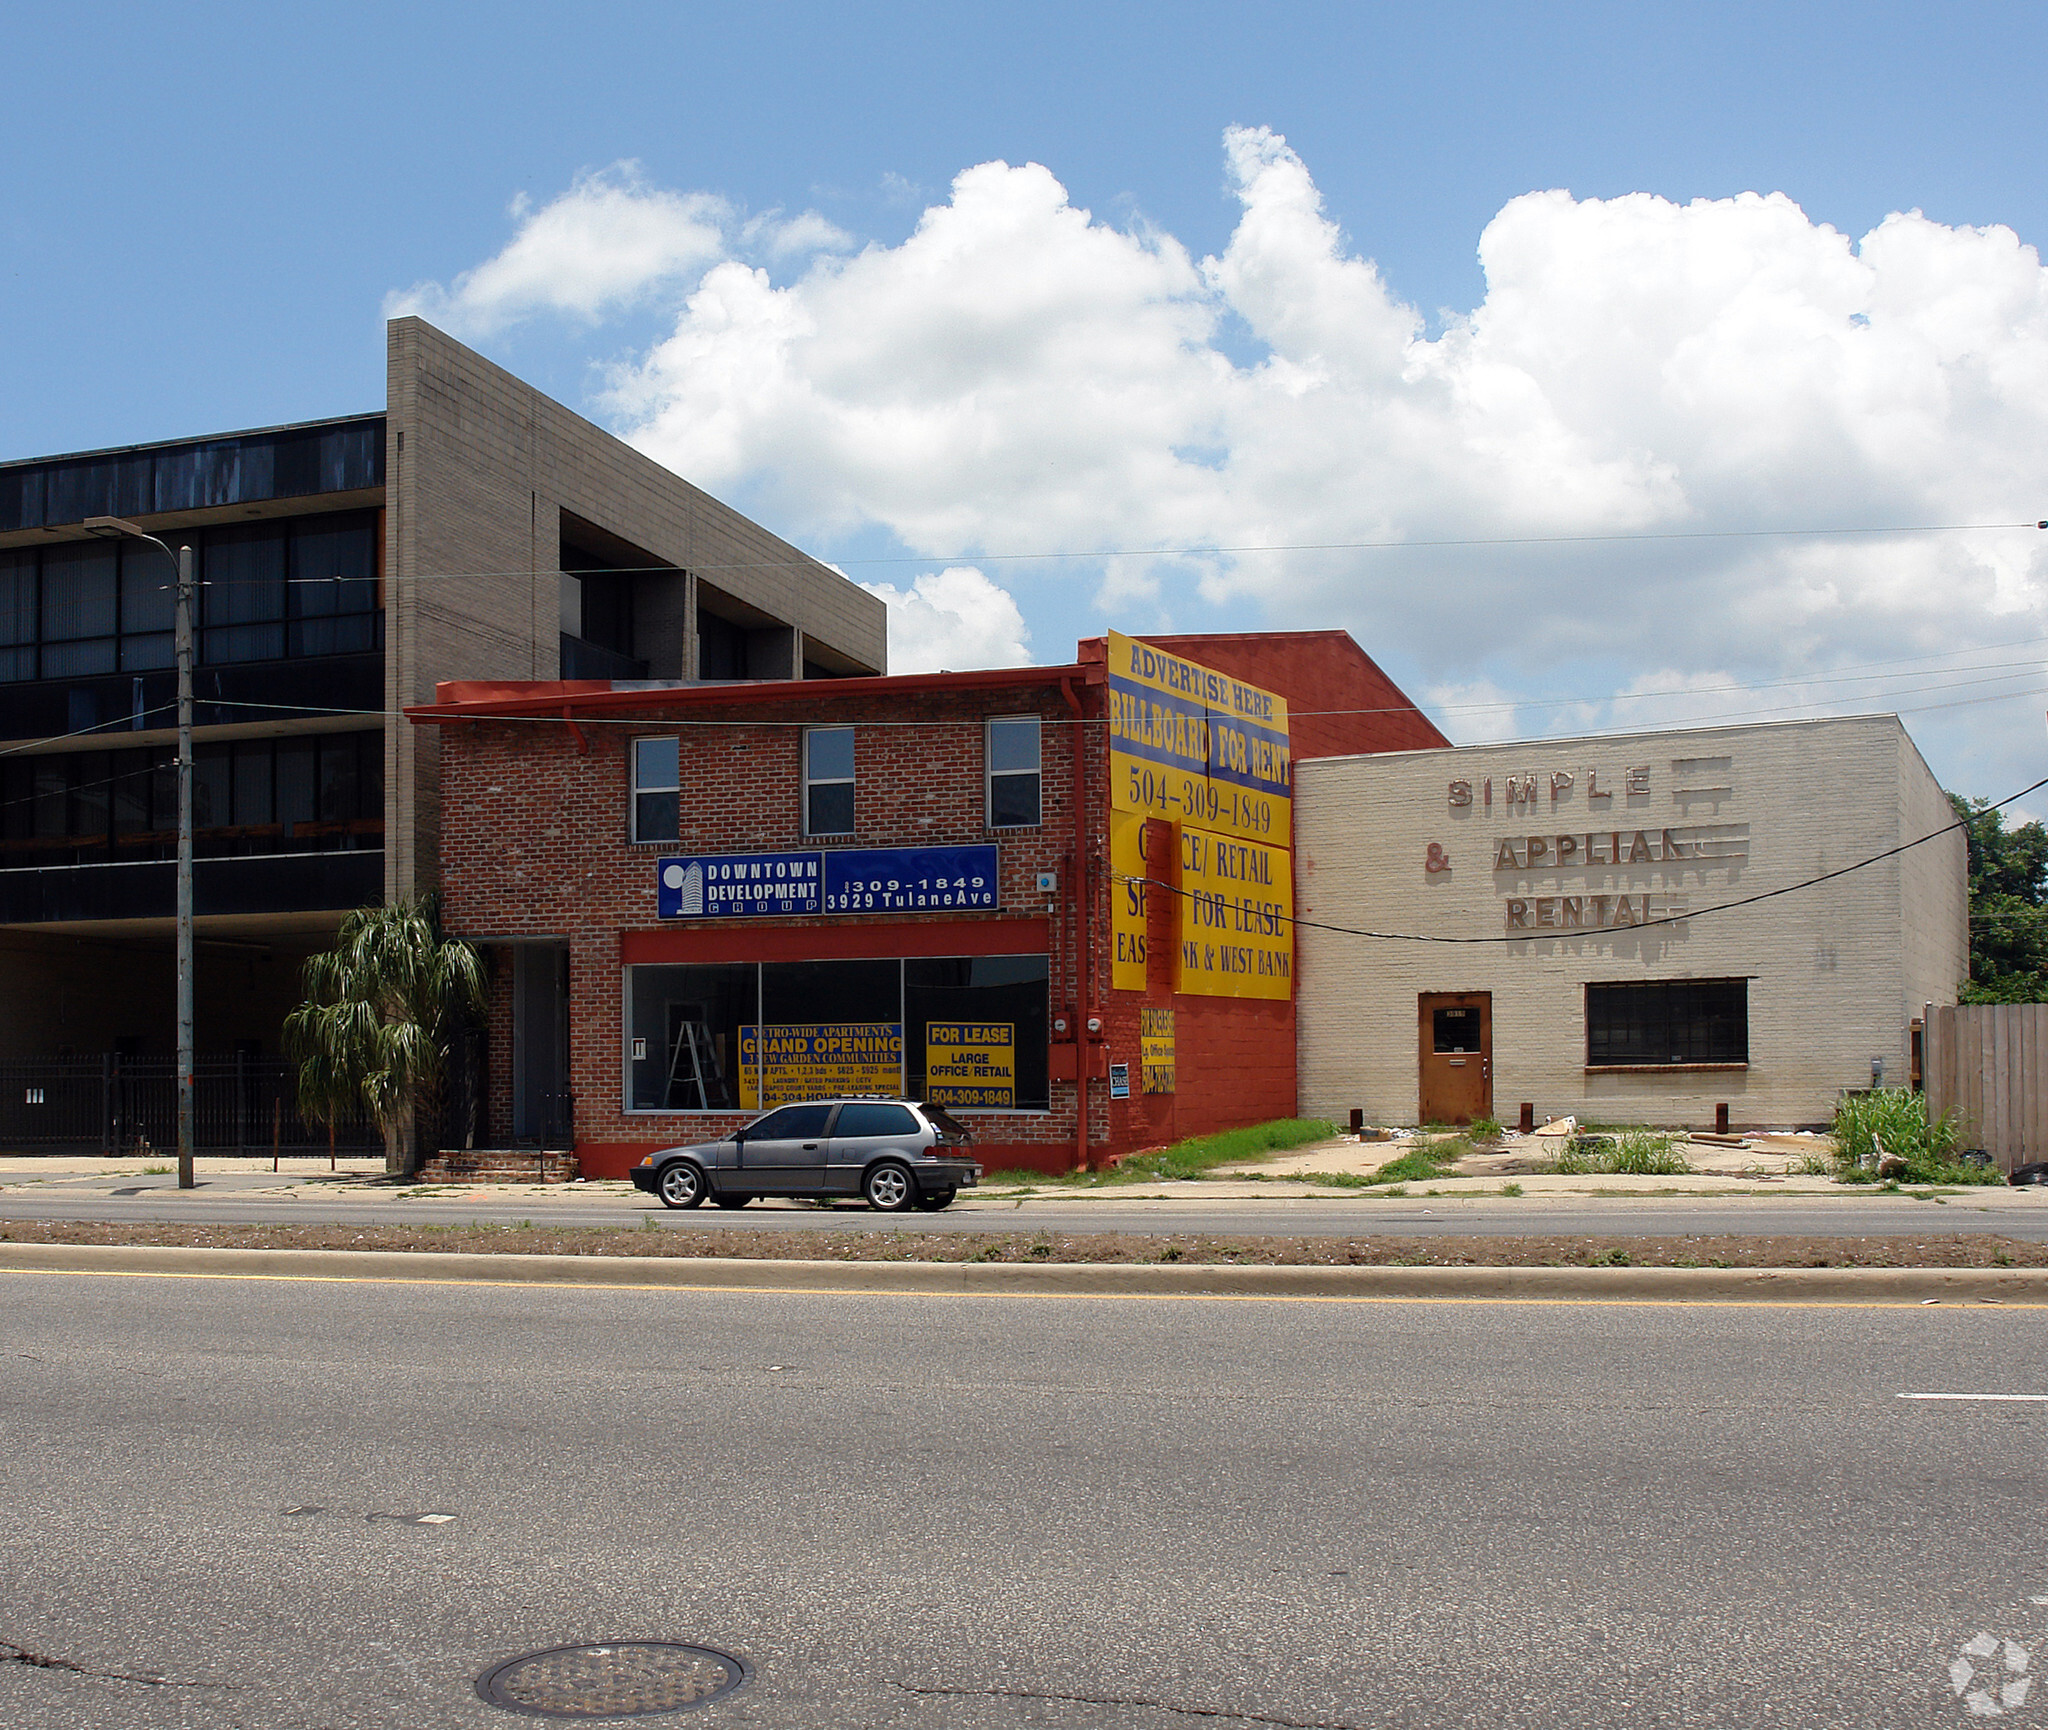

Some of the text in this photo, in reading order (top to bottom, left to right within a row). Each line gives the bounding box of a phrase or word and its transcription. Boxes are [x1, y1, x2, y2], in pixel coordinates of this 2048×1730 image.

[1131, 644, 1273, 722] ADVERTISE HERE
[1109, 688, 1290, 786] BILLBOARD FOR RENT
[1448, 766, 1650, 807] SIMPLE
[1130, 765, 1271, 834] 504-309-1849
[1217, 841, 1273, 886] RETAIL
[1425, 842, 1452, 873] &
[708, 861, 817, 880] DOWNTOWN
[708, 883, 817, 900] DEVELOPMENT
[852, 877, 985, 892] 309-1849
[708, 900, 817, 913] GROUP
[827, 893, 873, 910] 3929
[1193, 888, 1227, 929] FOR
[1235, 896, 1284, 937] LEASE
[1117, 932, 1146, 964] EAS
[1204, 943, 1214, 971] &
[1220, 945, 1254, 974] WEST
[1259, 949, 1290, 978] BANK
[752, 1026, 893, 1038] METRO-WIDE APARTMENTS
[932, 1027, 1009, 1043] FOR LEASE
[743, 1036, 902, 1053] GRAND OPENING
[748, 1053, 754, 1064] 3
[780, 1053, 820, 1064] GARDEN
[822, 1052, 897, 1063] COMMUNITIES
[951, 1053, 989, 1064] LARGE
[931, 1088, 1011, 1105] 504-309-1849
